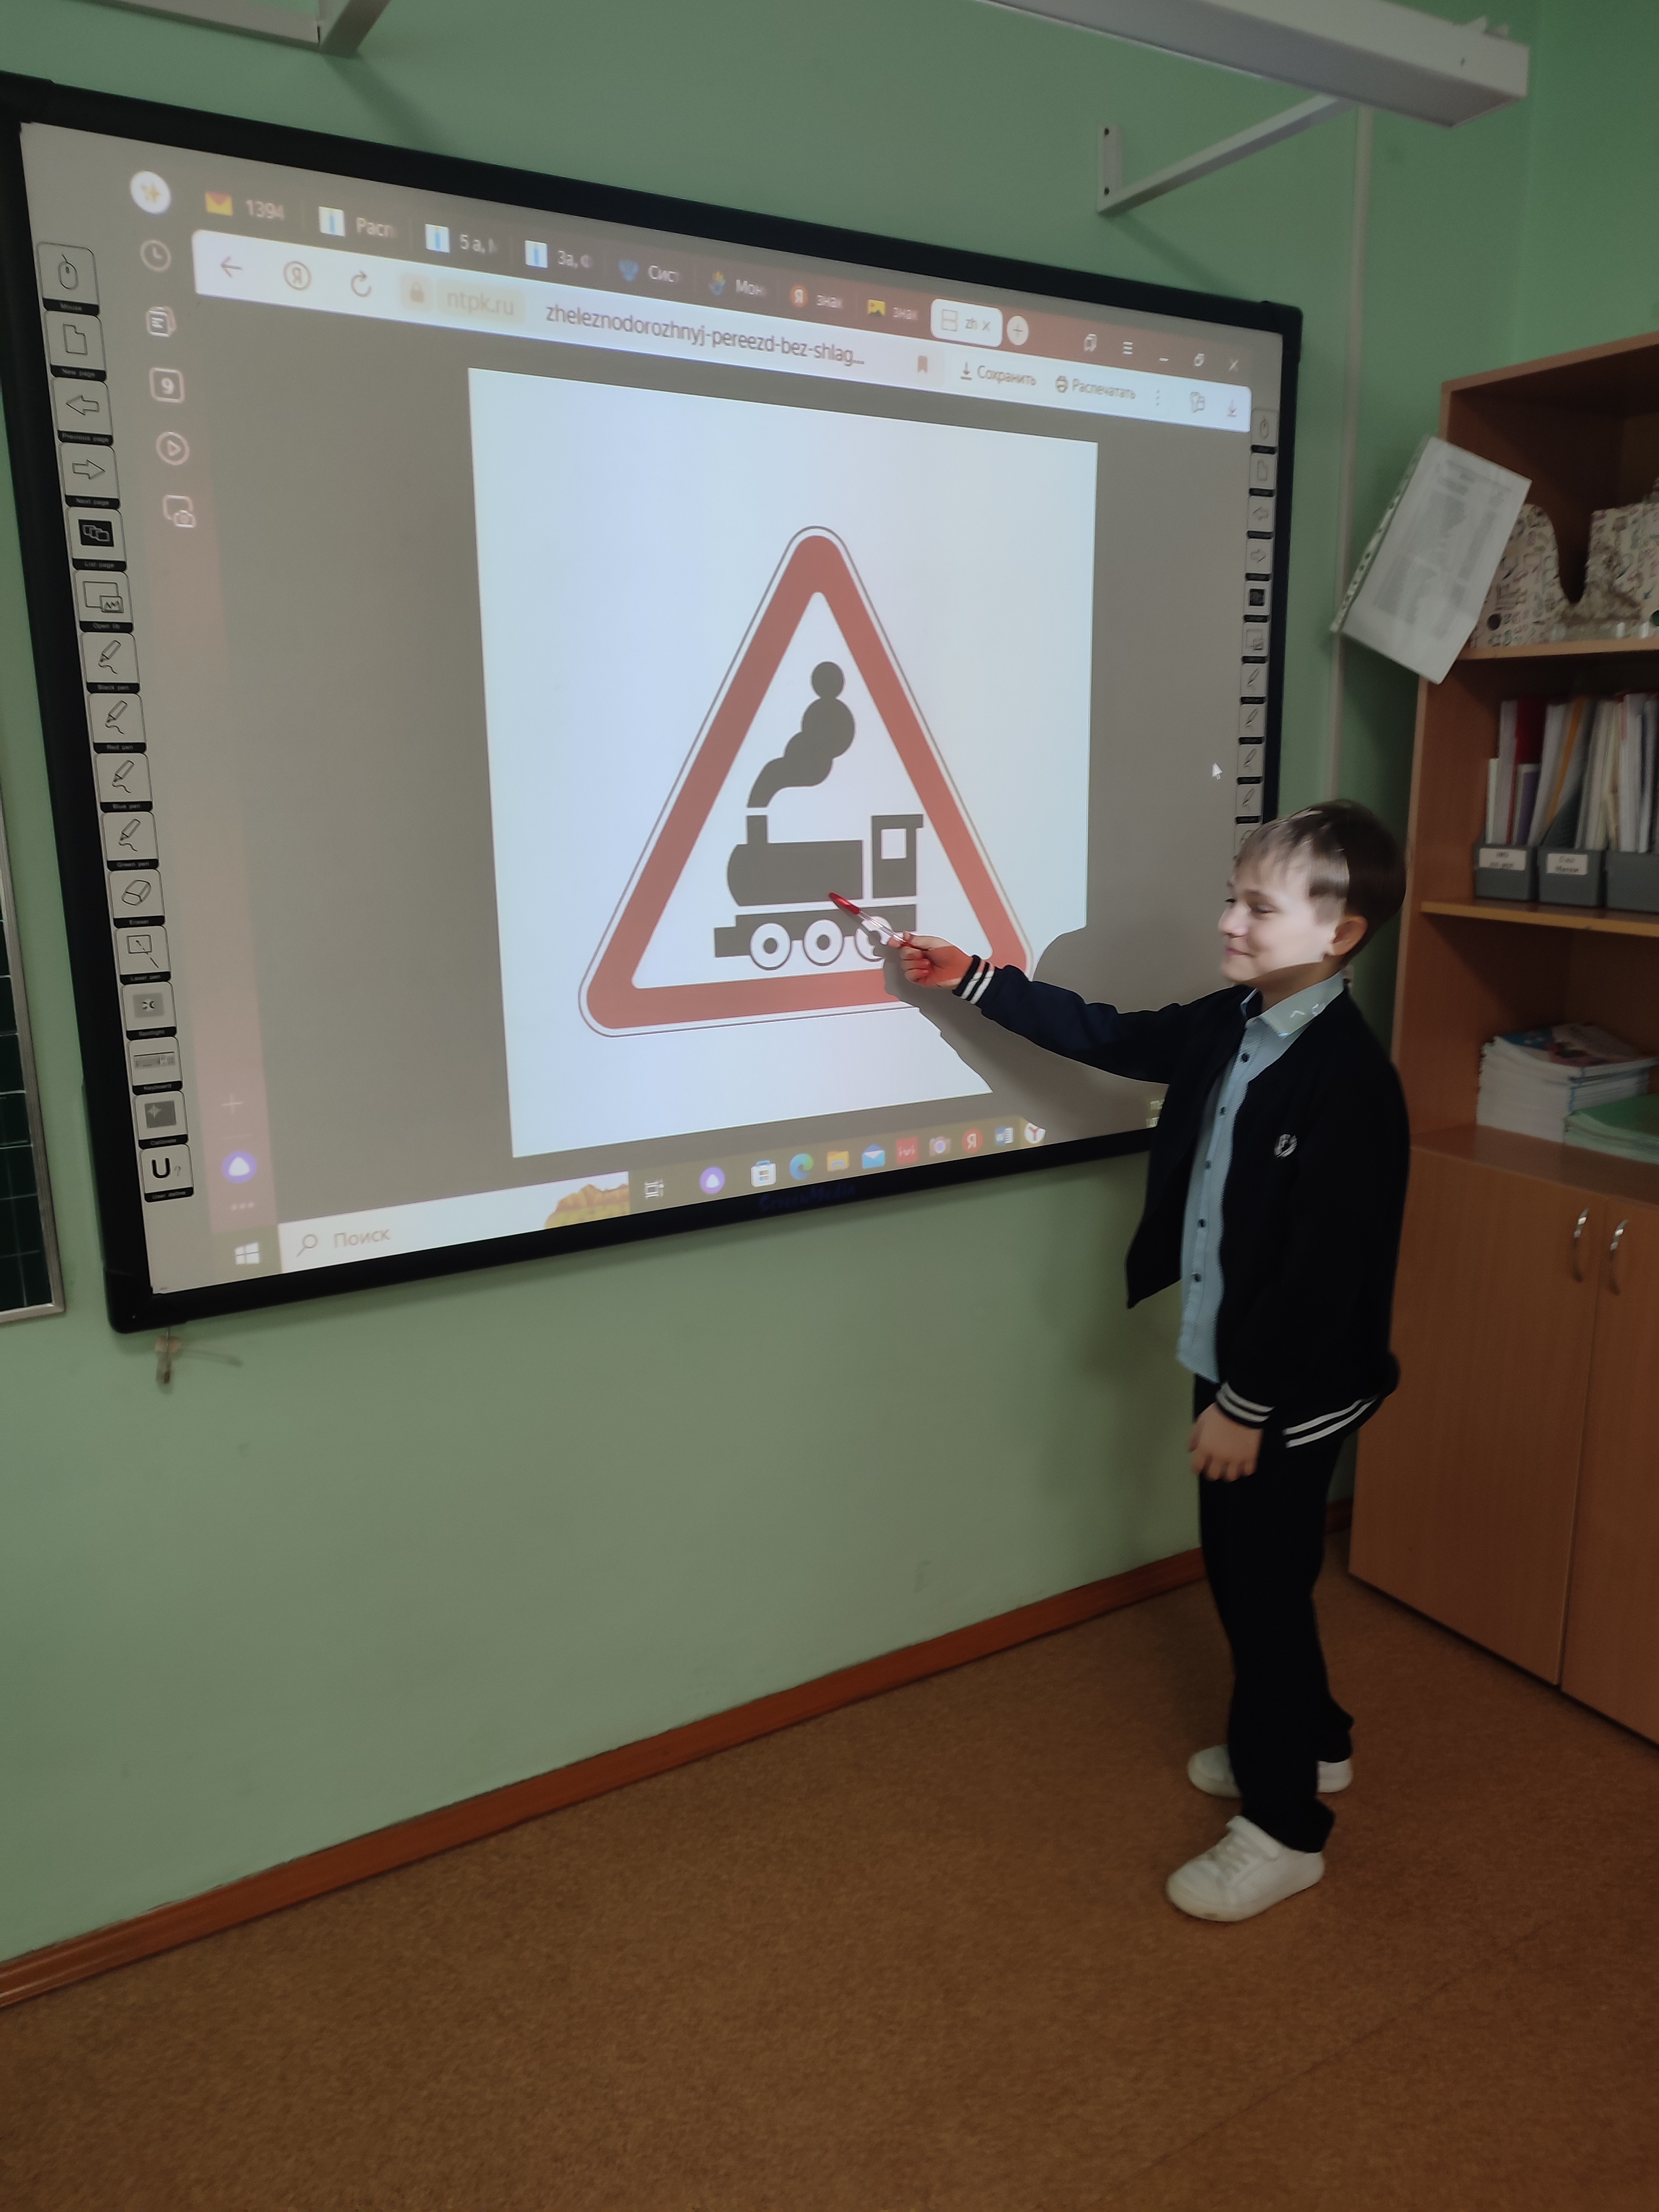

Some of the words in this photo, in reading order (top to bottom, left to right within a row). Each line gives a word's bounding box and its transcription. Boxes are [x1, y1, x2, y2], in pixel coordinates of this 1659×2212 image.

[447, 290, 514, 316] ntpk.ru
[977, 364, 1037, 386] Сохранить
[333, 1229, 390, 1249] Поиск
